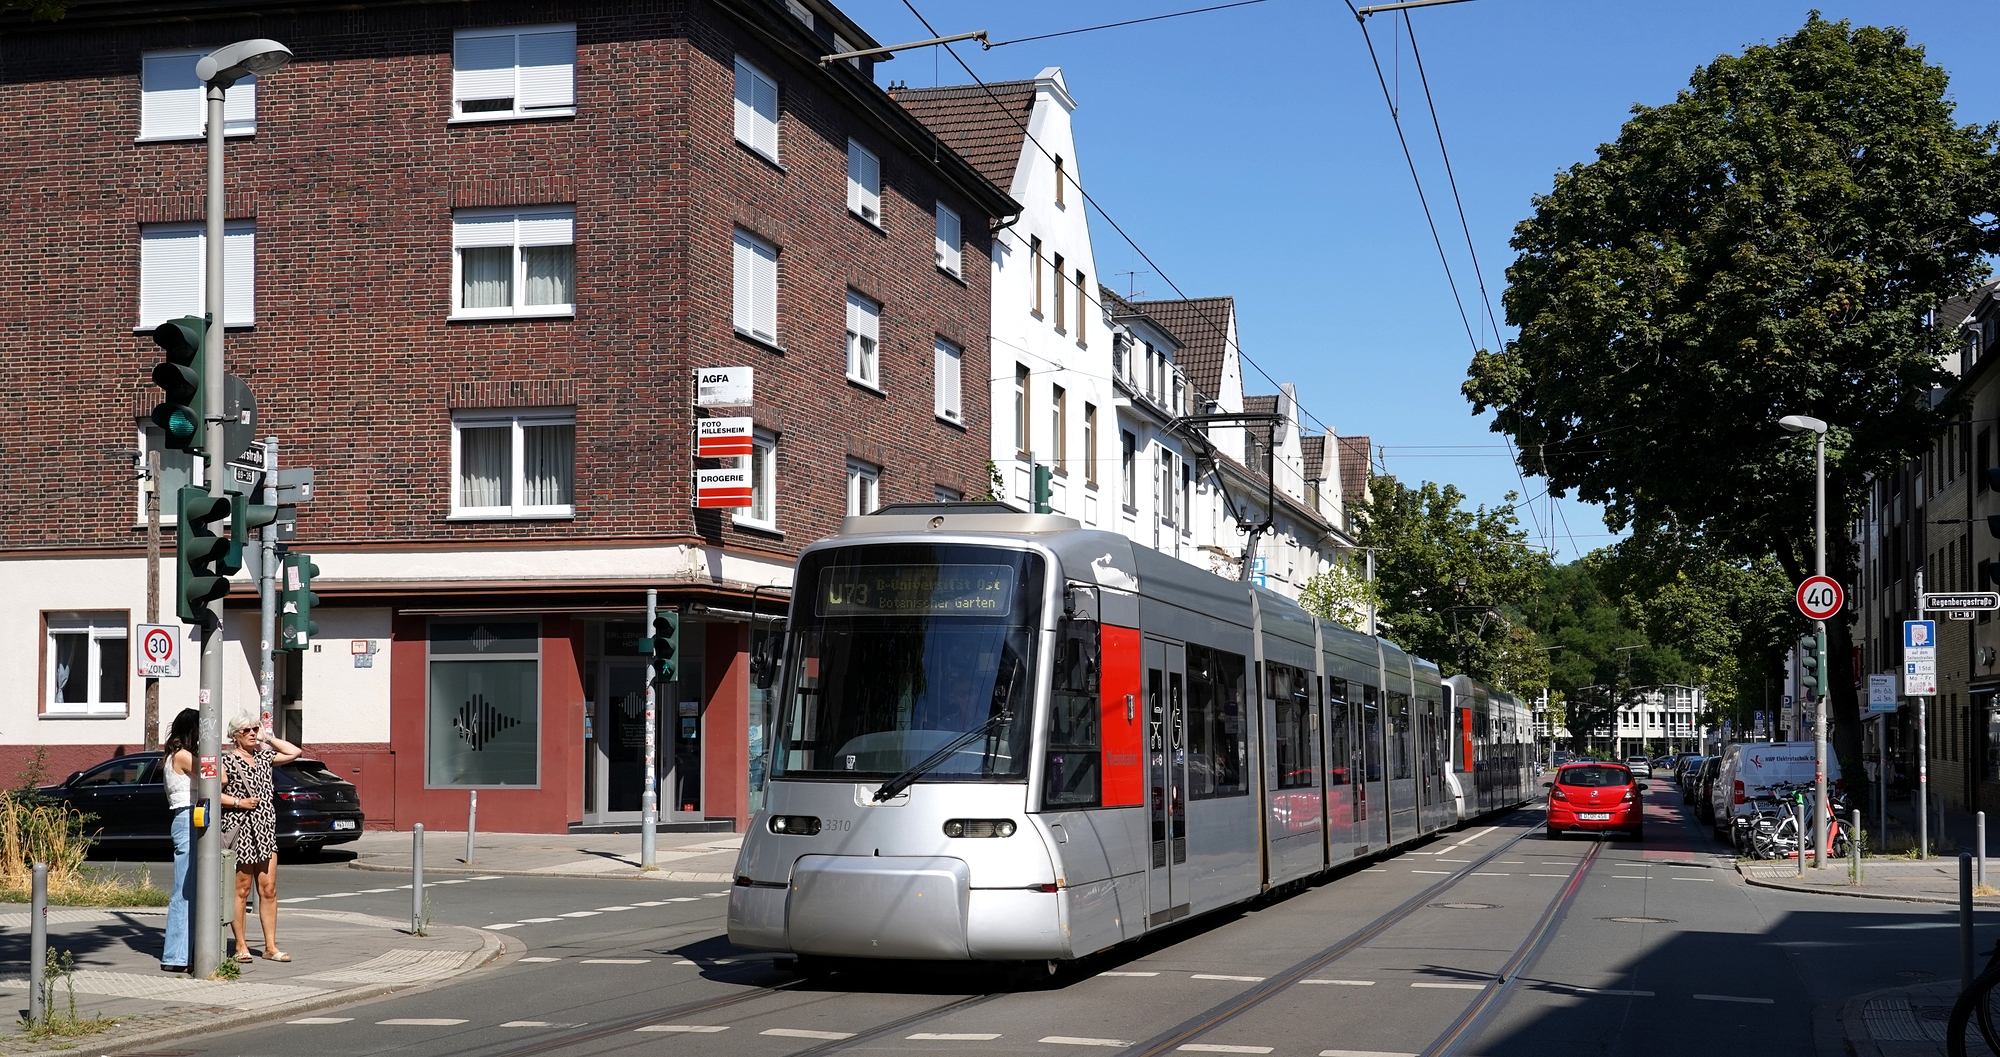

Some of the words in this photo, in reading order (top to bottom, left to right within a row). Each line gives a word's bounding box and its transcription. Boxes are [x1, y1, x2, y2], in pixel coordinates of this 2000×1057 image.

[702, 375, 729, 383] AGFA
[701, 427, 745, 435] HILLESHEIM
[700, 474, 744, 483] DROGERIE
[876, 578, 971, 591] D-Universität
[976, 579, 1001, 591] Ost
[829, 583, 869, 605] U73
[1806, 587, 1834, 608] 40
[879, 596, 950, 608] Botanischer
[954, 596, 996, 609] Garten
[1931, 598, 1993, 607] Regenbergastraße
[150, 637, 167, 654] 30
[148, 664, 170, 674] ZONE
[1105, 748, 1138, 766] Rheinbahn
[824, 819, 852, 832] 3310
